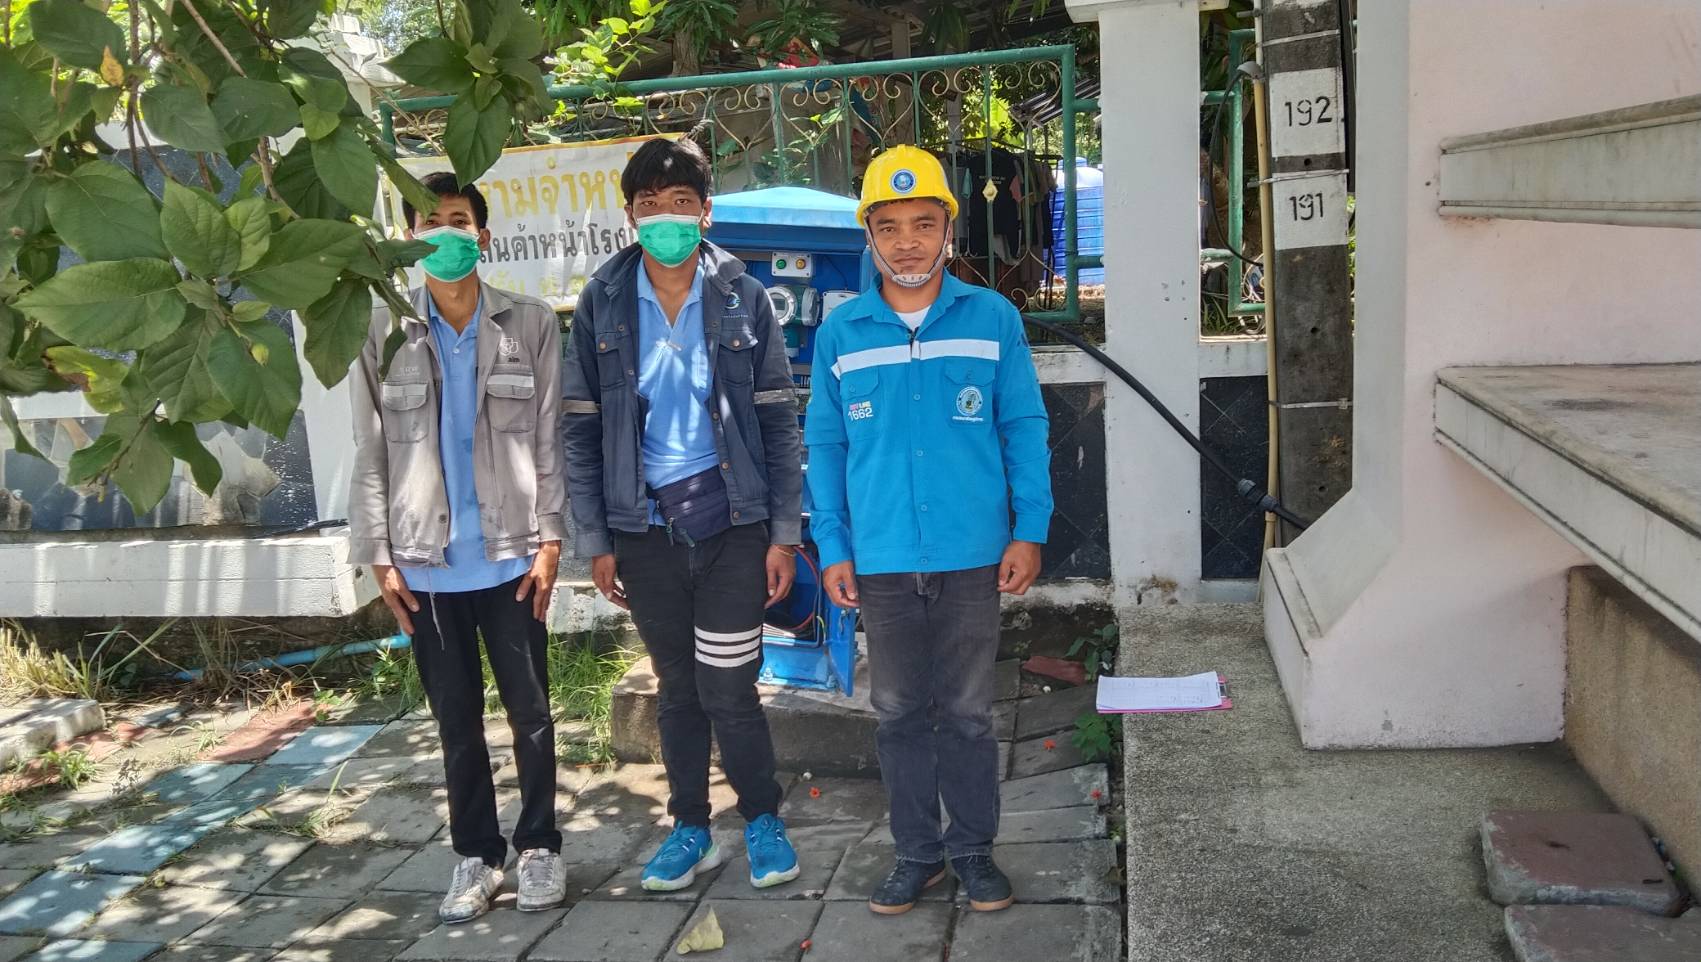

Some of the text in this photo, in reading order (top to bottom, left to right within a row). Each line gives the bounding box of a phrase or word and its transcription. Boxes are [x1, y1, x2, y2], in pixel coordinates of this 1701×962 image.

[1284, 95, 1333, 127] 192
[1288, 191, 1325, 222] 191
[848, 407, 874, 421] 1662
